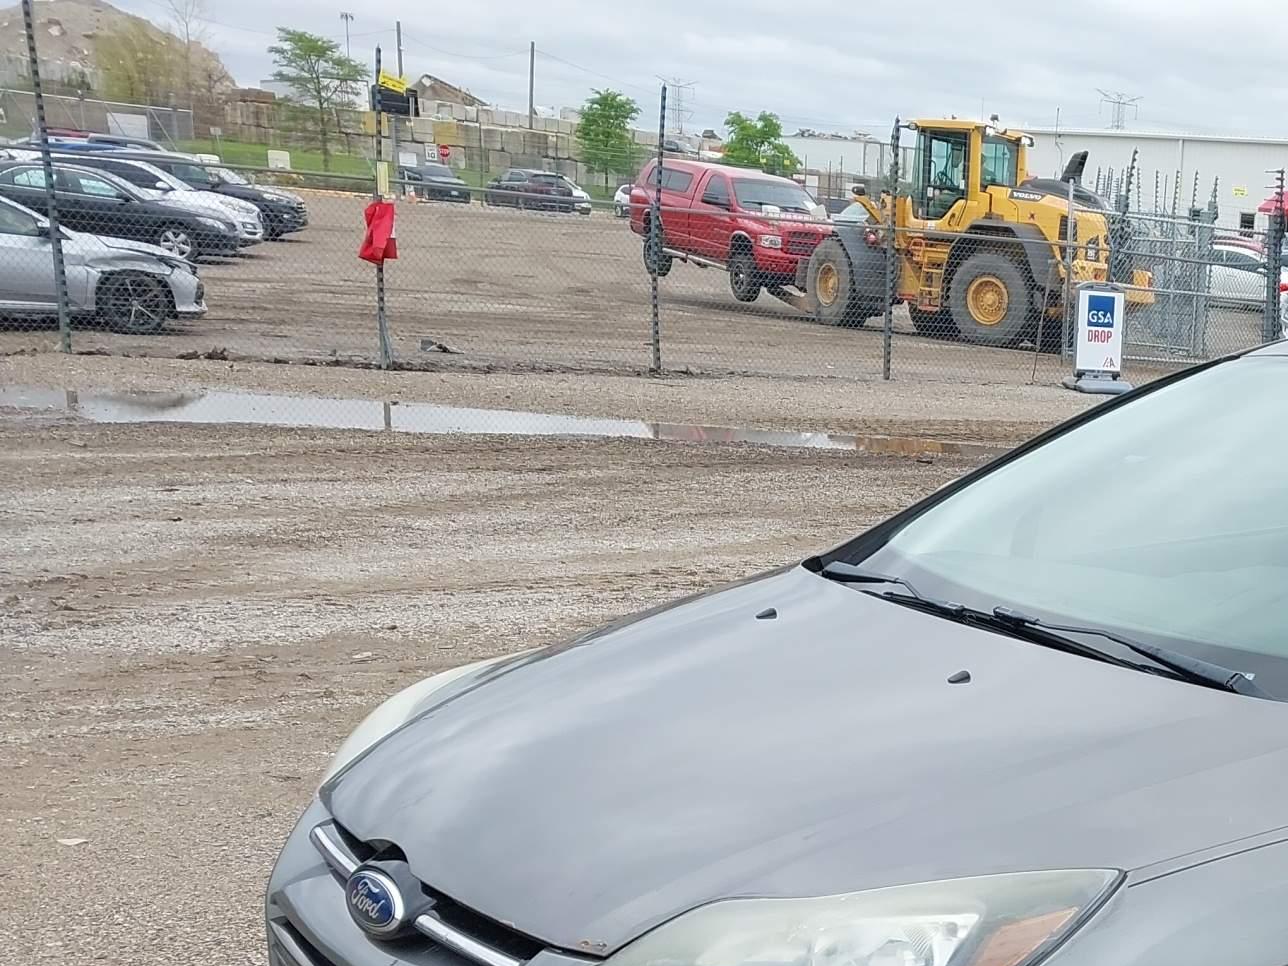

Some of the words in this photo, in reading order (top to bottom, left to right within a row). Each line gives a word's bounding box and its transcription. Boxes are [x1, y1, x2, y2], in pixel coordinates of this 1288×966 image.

[1013, 191, 1042, 200] VOLVO
[1088, 310, 1113, 324] GSA
[1087, 329, 1113, 343] DROP
[351, 878, 386, 919] Ford
